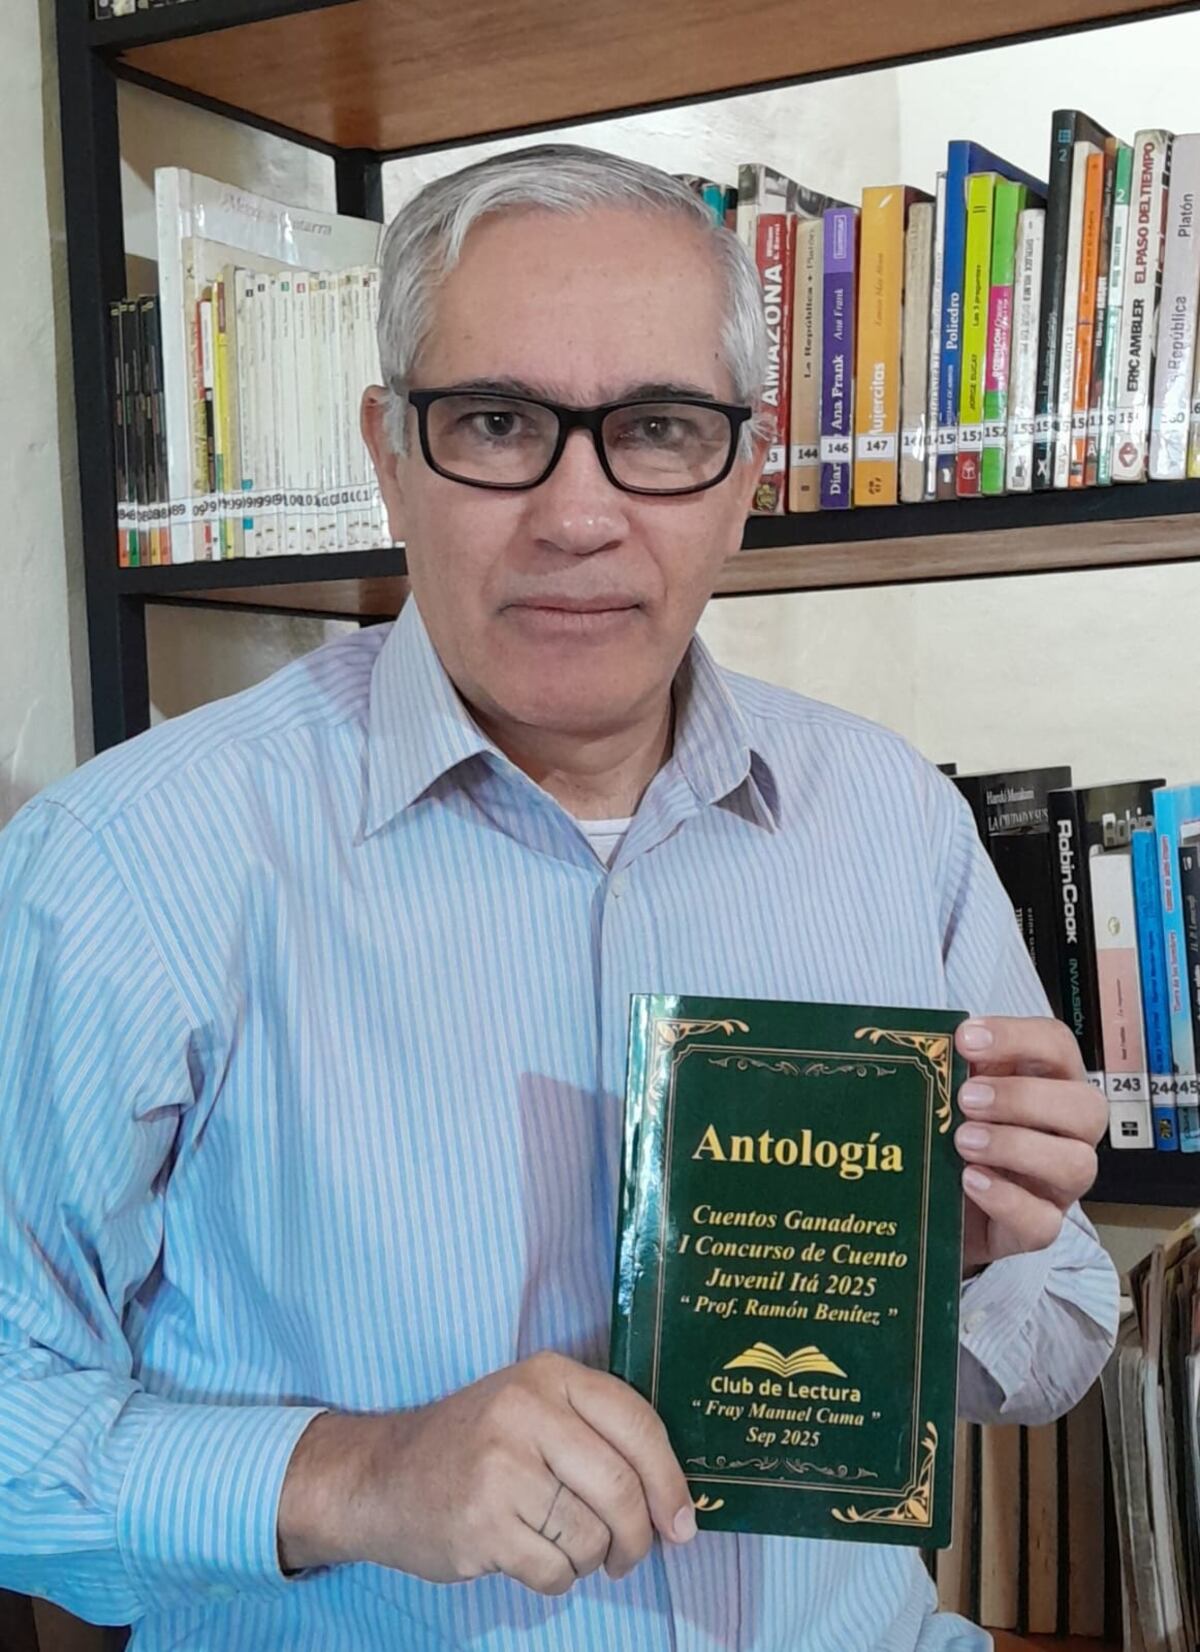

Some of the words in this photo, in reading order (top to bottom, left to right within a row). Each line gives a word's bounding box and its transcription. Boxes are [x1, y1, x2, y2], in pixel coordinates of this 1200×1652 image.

[1139, 142, 1155, 200] TIEMPO
[1116, 189, 1126, 203] 2
[1138, 199, 1151, 224] DEL
[1177, 193, 1194, 238] Platón
[1135, 226, 1150, 266] PASO
[1134, 266, 1147, 284] EL
[833, 287, 845, 317] Frank
[804, 287, 813, 357] República
[833, 319, 844, 341] Ana
[945, 291, 960, 350] Poliedro
[972, 311, 980, 327] Las
[1129, 298, 1145, 357] AMBLER
[1168, 296, 1187, 370] República
[762, 263, 783, 407] AMAZONA
[832, 354, 844, 399] Frank
[1127, 358, 1141, 392] ERIC
[831, 402, 843, 430] Ana
[866, 440, 888, 451] 147
[962, 430, 982, 442] 151
[985, 426, 1007, 438] 152
[798, 448, 818, 460] 144
[828, 442, 849, 454] 146
[1057, 819, 1075, 884] Robin
[1062, 883, 1078, 944] Cook
[1068, 958, 1084, 1036] INVASIÓN
[1112, 1078, 1141, 1092] 243
[691, 1123, 904, 1181] Antología
[692, 1204, 777, 1229] Cuentos
[784, 1209, 898, 1236] Ganadores
[678, 1234, 690, 1254] I
[695, 1235, 795, 1261] Concurso
[800, 1242, 825, 1262] de
[832, 1243, 908, 1268] Cuento
[705, 1267, 783, 1291] Juvenil
[789, 1271, 820, 1293] Itá
[825, 1274, 877, 1297] 2025
[694, 1295, 739, 1320] Prof.
[744, 1298, 808, 1320] Ramón
[814, 1302, 881, 1326] Benítez
[710, 1375, 754, 1395] Club
[759, 1378, 783, 1397] de
[788, 1380, 861, 1403] Lectura
[704, 1399, 745, 1421] Fray
[748, 1403, 812, 1423] Manuel
[816, 1407, 865, 1427] Cuma
[746, 1426, 776, 1448] Sep
[781, 1428, 821, 1447] 2025
